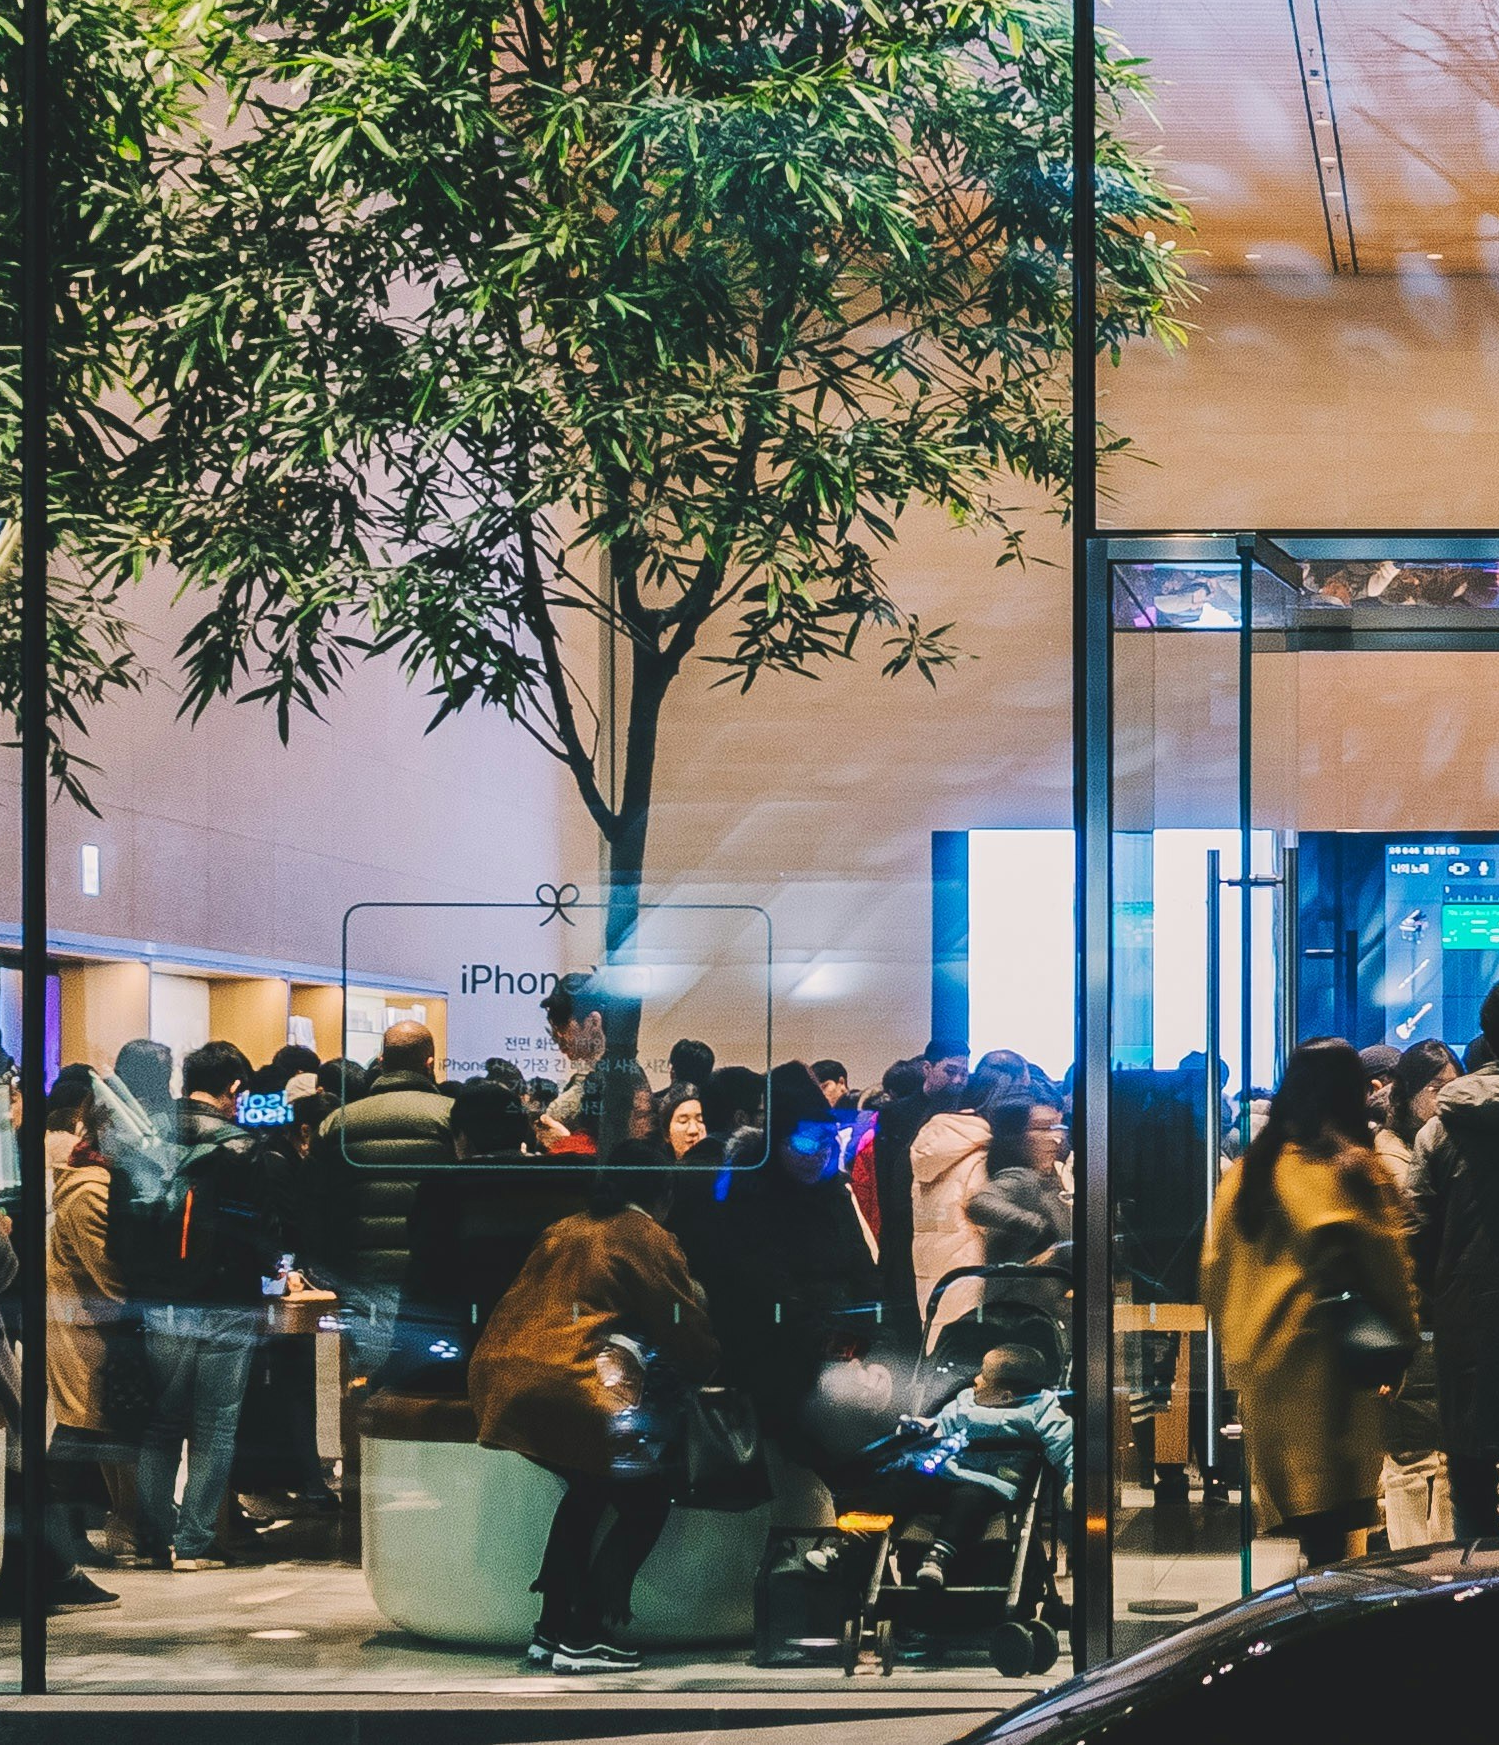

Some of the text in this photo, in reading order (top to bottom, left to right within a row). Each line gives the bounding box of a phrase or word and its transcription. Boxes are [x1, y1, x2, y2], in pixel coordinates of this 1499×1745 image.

[504, 1036, 531, 1051] 전면
[522, 1058, 548, 1073] 가장
[554, 1059, 566, 1073] 긴
